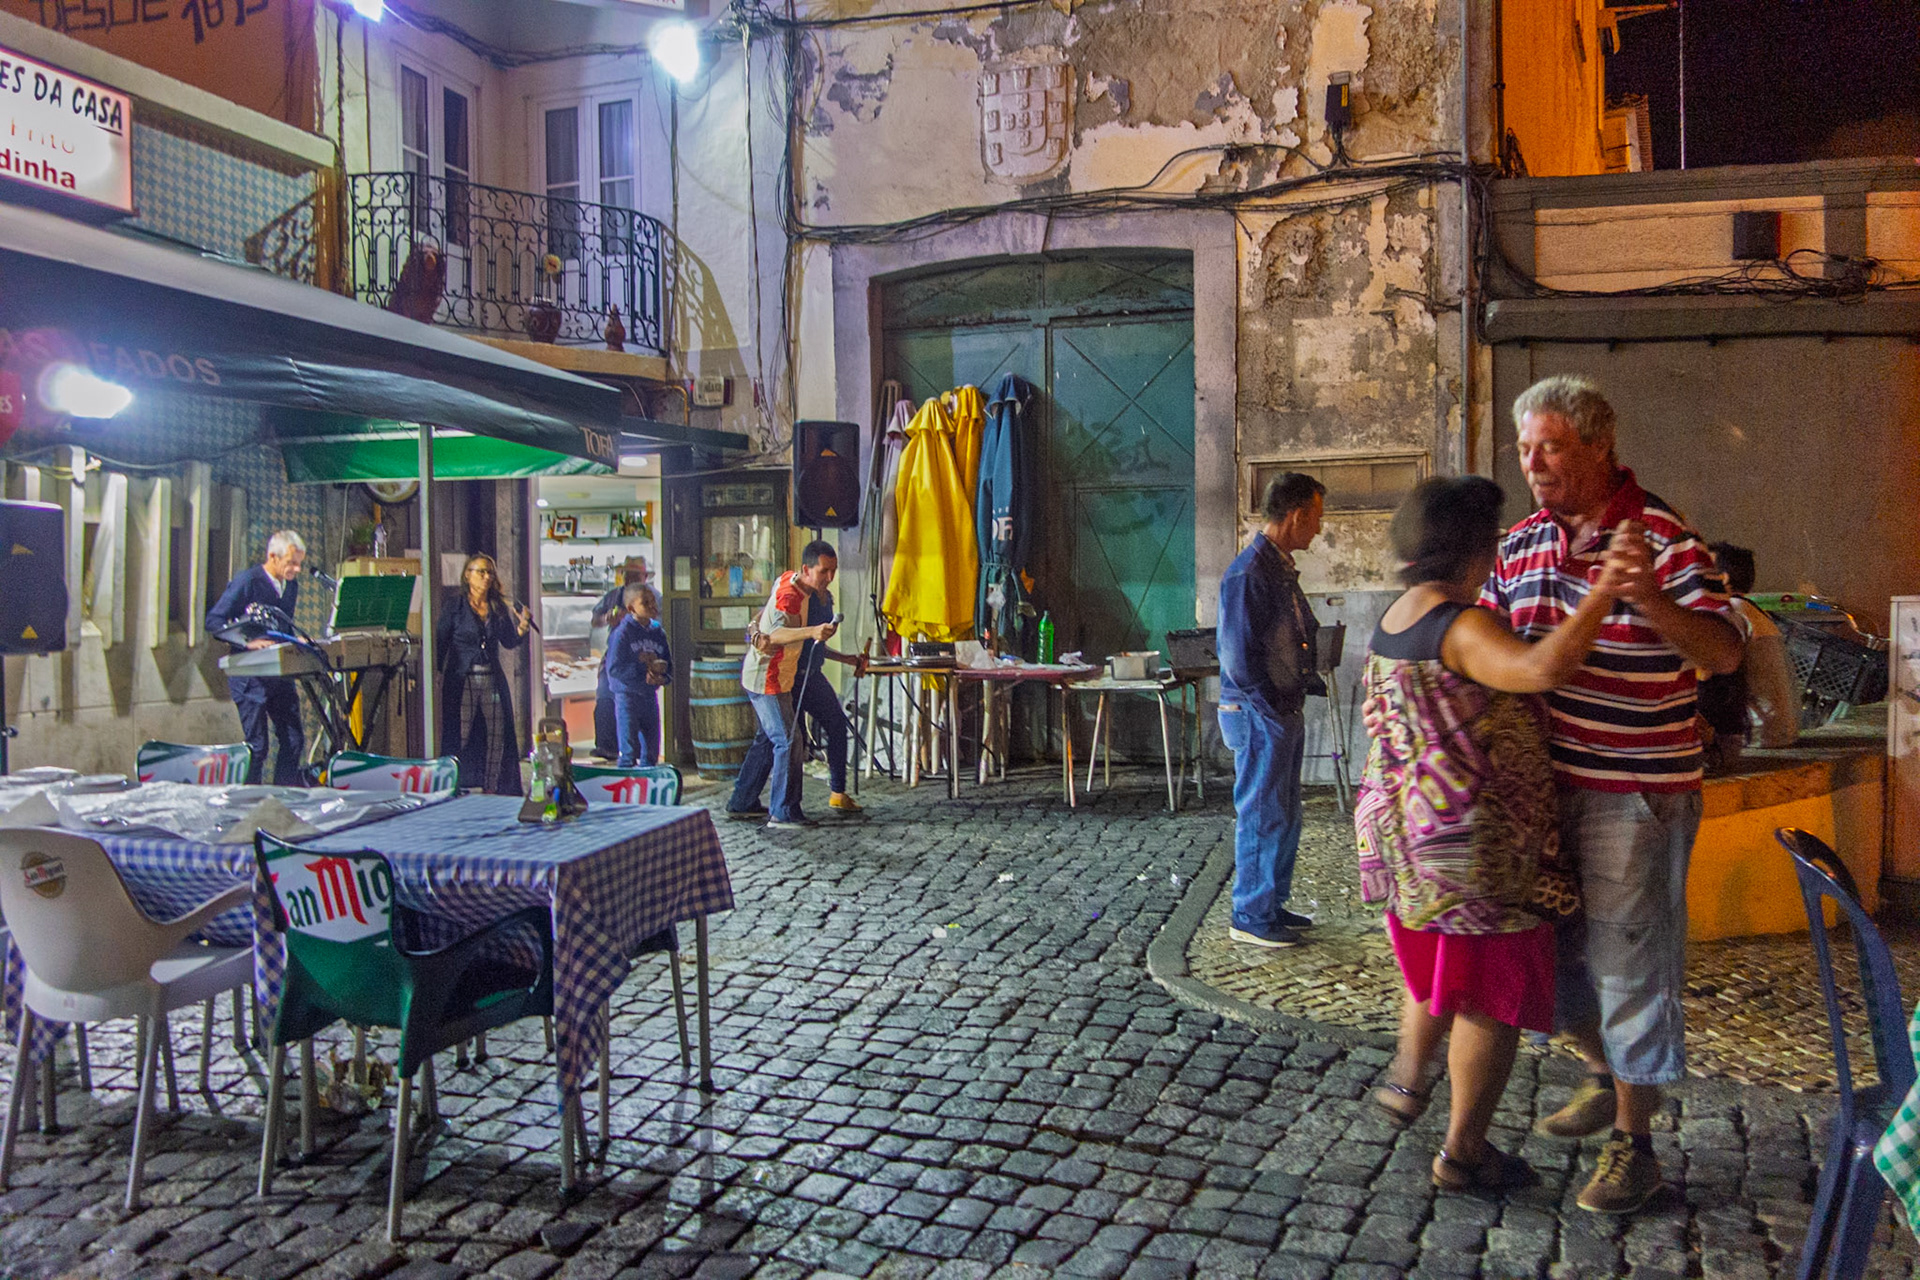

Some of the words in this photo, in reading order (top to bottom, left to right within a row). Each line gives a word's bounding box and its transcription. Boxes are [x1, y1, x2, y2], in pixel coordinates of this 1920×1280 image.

[34, 72, 62, 108] DA
[72, 86, 122, 130] CASA
[270, 872, 322, 928] an
